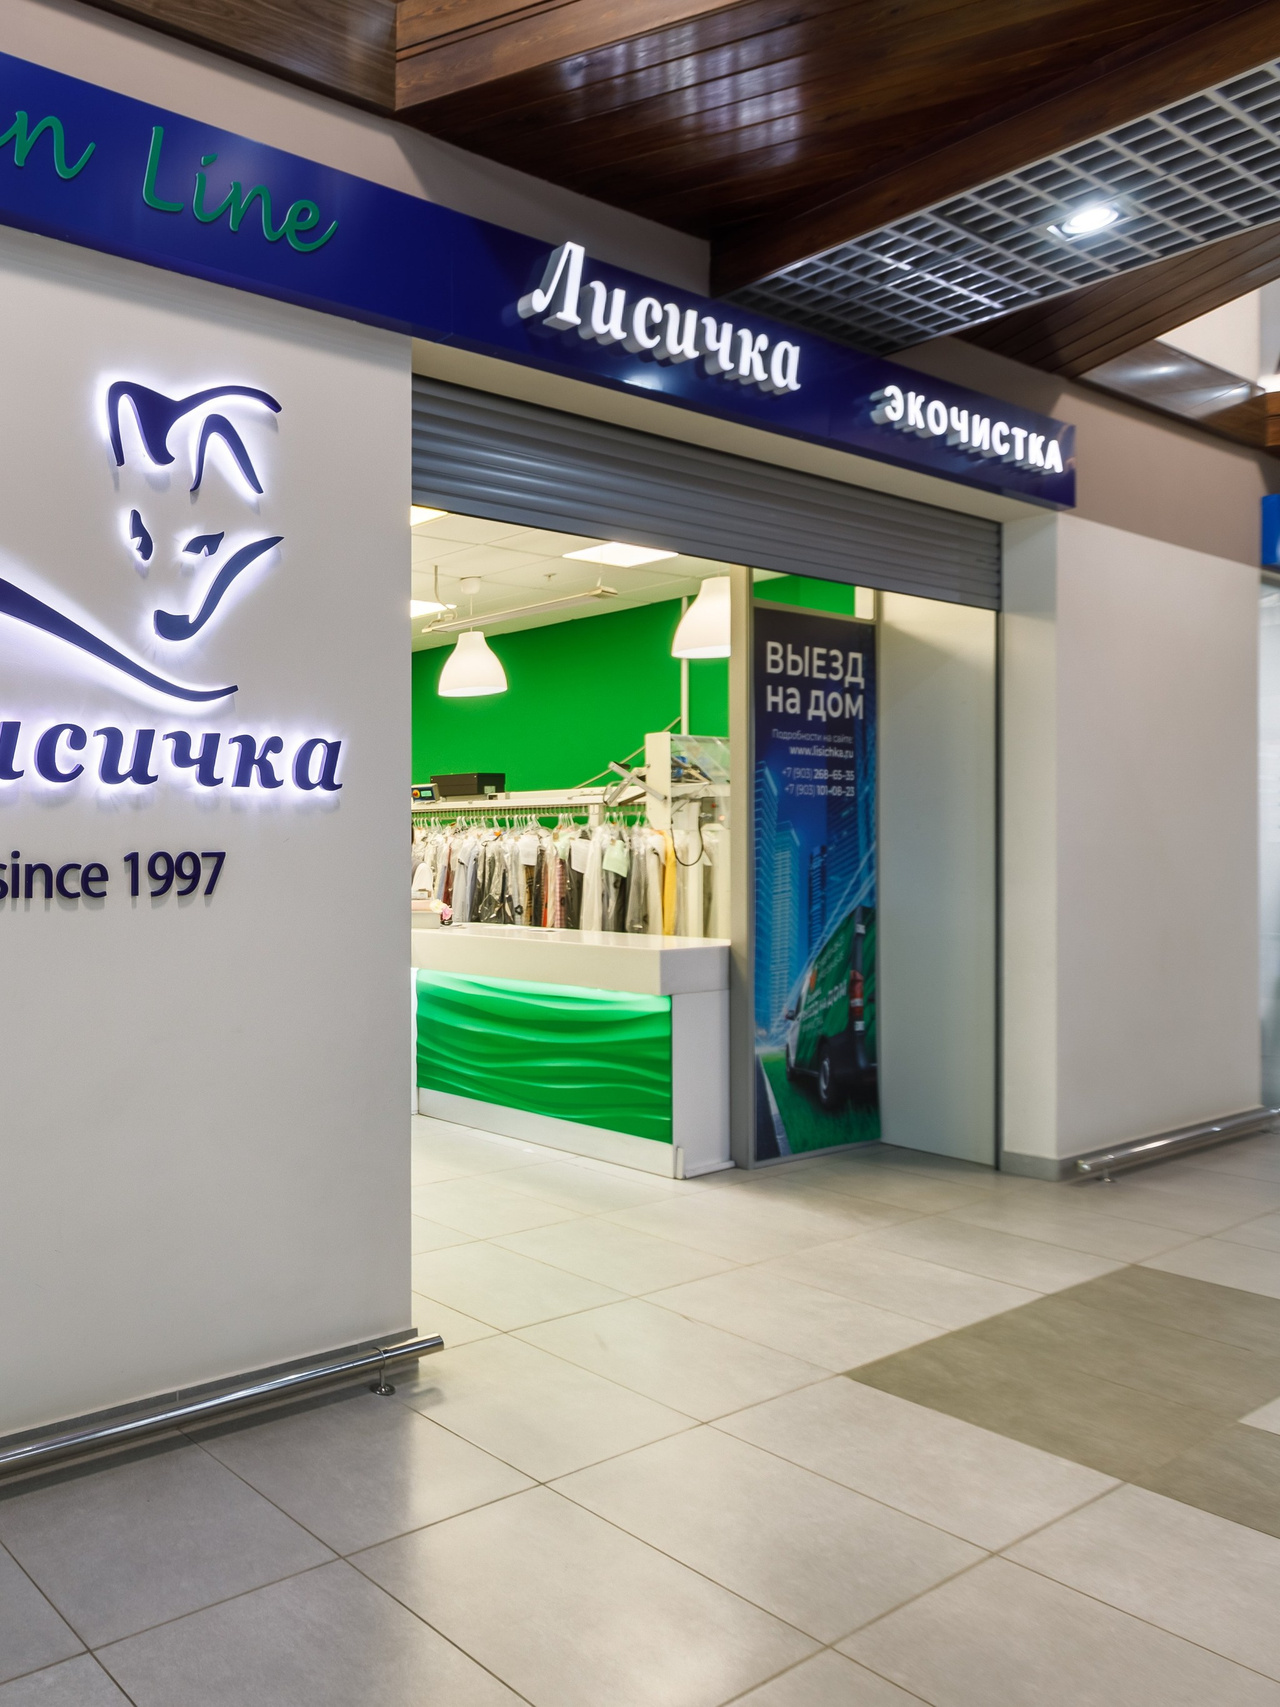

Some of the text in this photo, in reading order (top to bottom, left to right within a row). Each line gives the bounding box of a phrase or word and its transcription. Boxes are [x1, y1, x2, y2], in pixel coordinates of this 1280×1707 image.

[142, 125, 339, 253] Line
[519, 240, 802, 395] Лисичка
[766, 640, 865, 690] ВЫЕЗД
[766, 684, 801, 715] на
[123, 851, 226, 897] 1997
